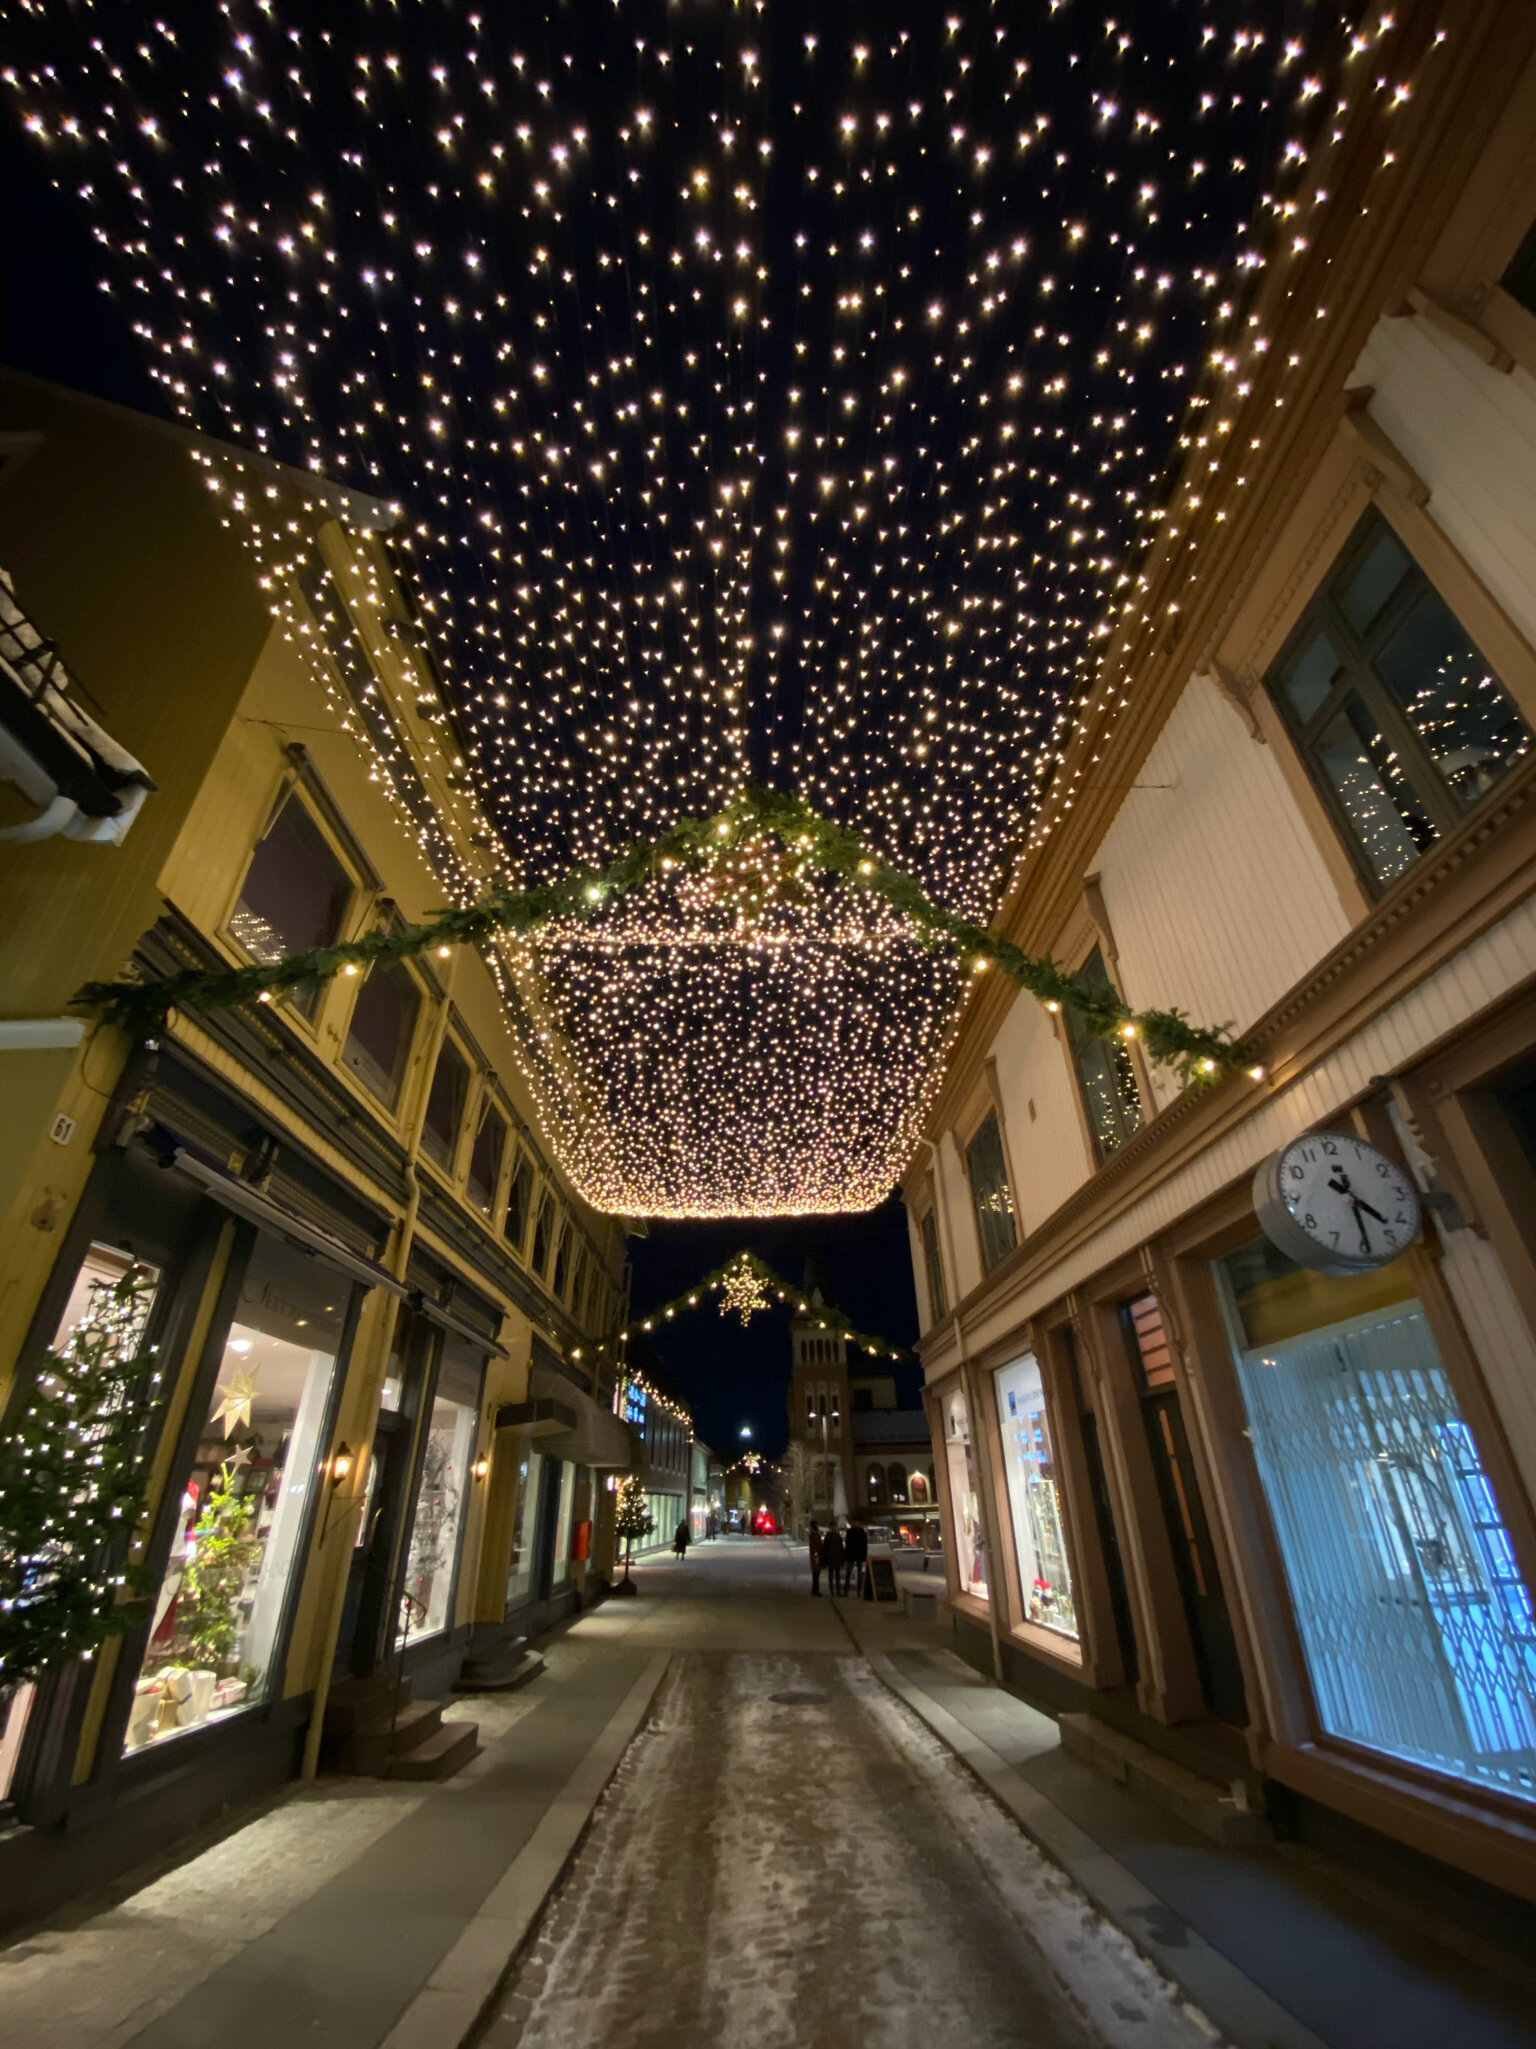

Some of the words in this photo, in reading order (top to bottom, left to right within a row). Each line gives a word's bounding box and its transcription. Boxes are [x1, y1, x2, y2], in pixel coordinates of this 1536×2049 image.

[54, 1118, 73, 1141] 61
[1321, 1141, 1338, 1155] 12
[1354, 1147, 1362, 1160] 1
[1302, 1149, 1317, 1163] 11
[1290, 1165, 1304, 1180] 10
[1376, 1163, 1390, 1178] 2
[1392, 1186, 1406, 1202] 3
[1305, 1213, 1318, 1229] 8
[1395, 1212, 1408, 1225] 4
[1328, 1231, 1341, 1247] 7
[1383, 1230, 1396, 1246] 5
